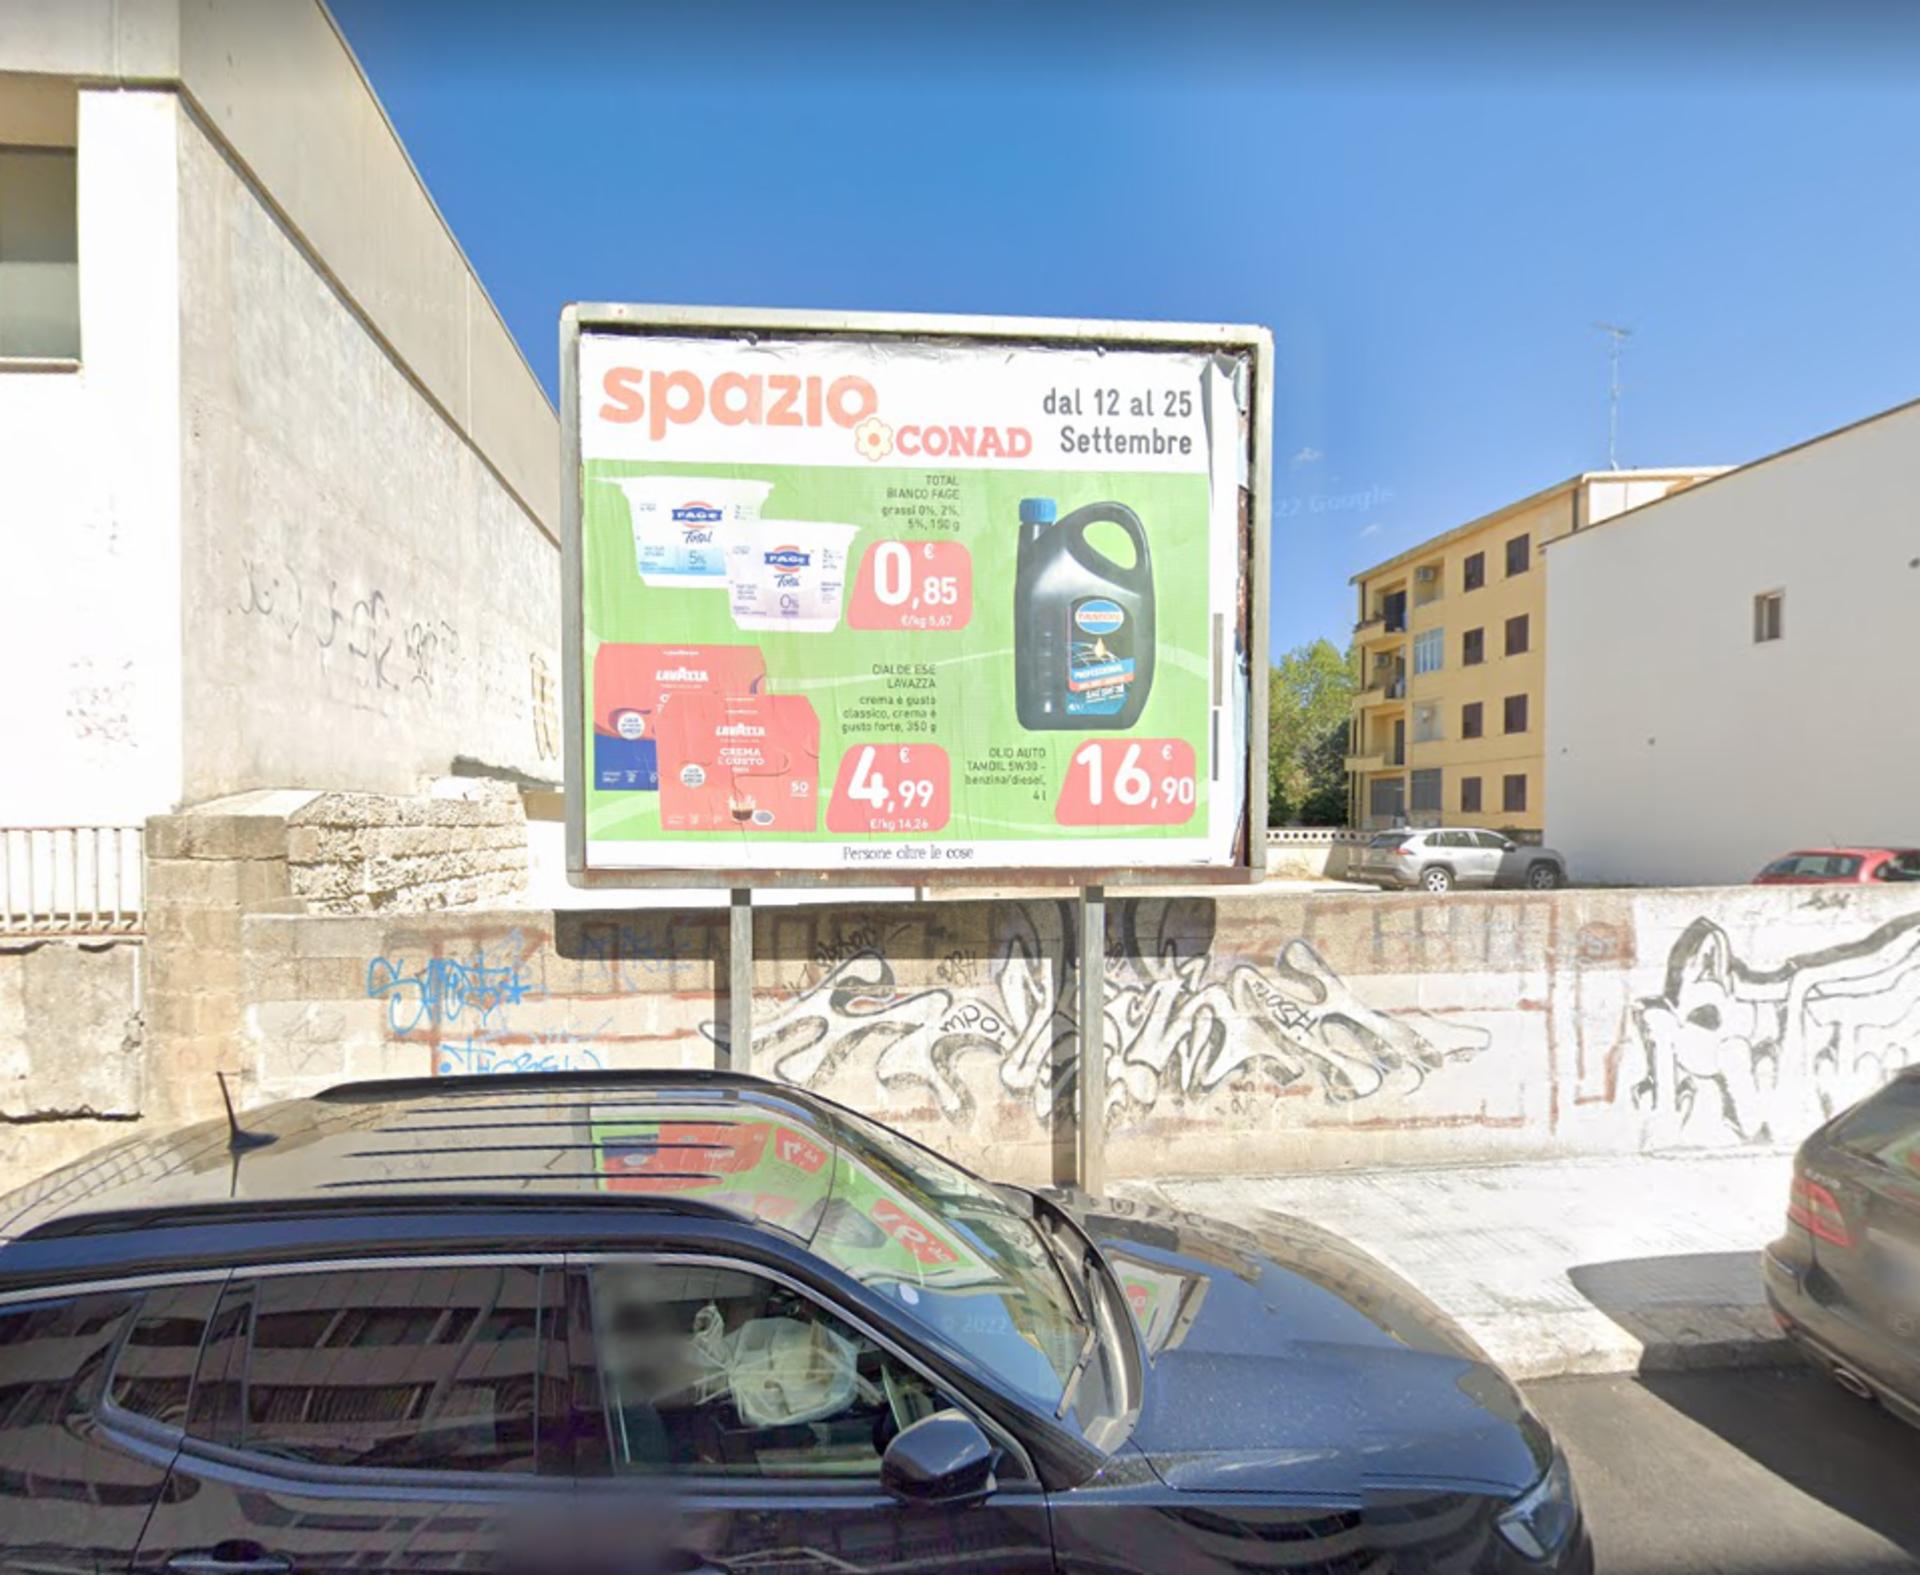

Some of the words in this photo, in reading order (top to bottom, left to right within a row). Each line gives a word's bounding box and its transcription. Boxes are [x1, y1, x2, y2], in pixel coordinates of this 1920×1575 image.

[599, 367, 878, 441] spazio
[1043, 387, 1082, 416] dal
[1094, 388, 1120, 416] 12
[1130, 389, 1155, 417] al
[1164, 391, 1192, 418] 25
[896, 425, 1033, 459] CONAD
[1060, 427, 1192, 454] Settembre
[926, 475, 960, 486] TOTAL
[886, 487, 929, 500] BIANCO
[931, 488, 960, 500] FAGE
[881, 505, 916, 517] grassi
[887, 678, 936, 688] LAVAZZA
[859, 696, 894, 705] crema
[892, 709, 927, 718] crema
[842, 722, 871, 734] gusto
[906, 720, 927, 732] 350
[988, 747, 1014, 759] OLIO
[1017, 747, 1046, 759] AUTO
[967, 761, 1006, 772] TAMOIL
[843, 846, 892, 860] Persone
[896, 845, 927, 860] oltre
[930, 844, 942, 859] le
[946, 847, 974, 859] cose
